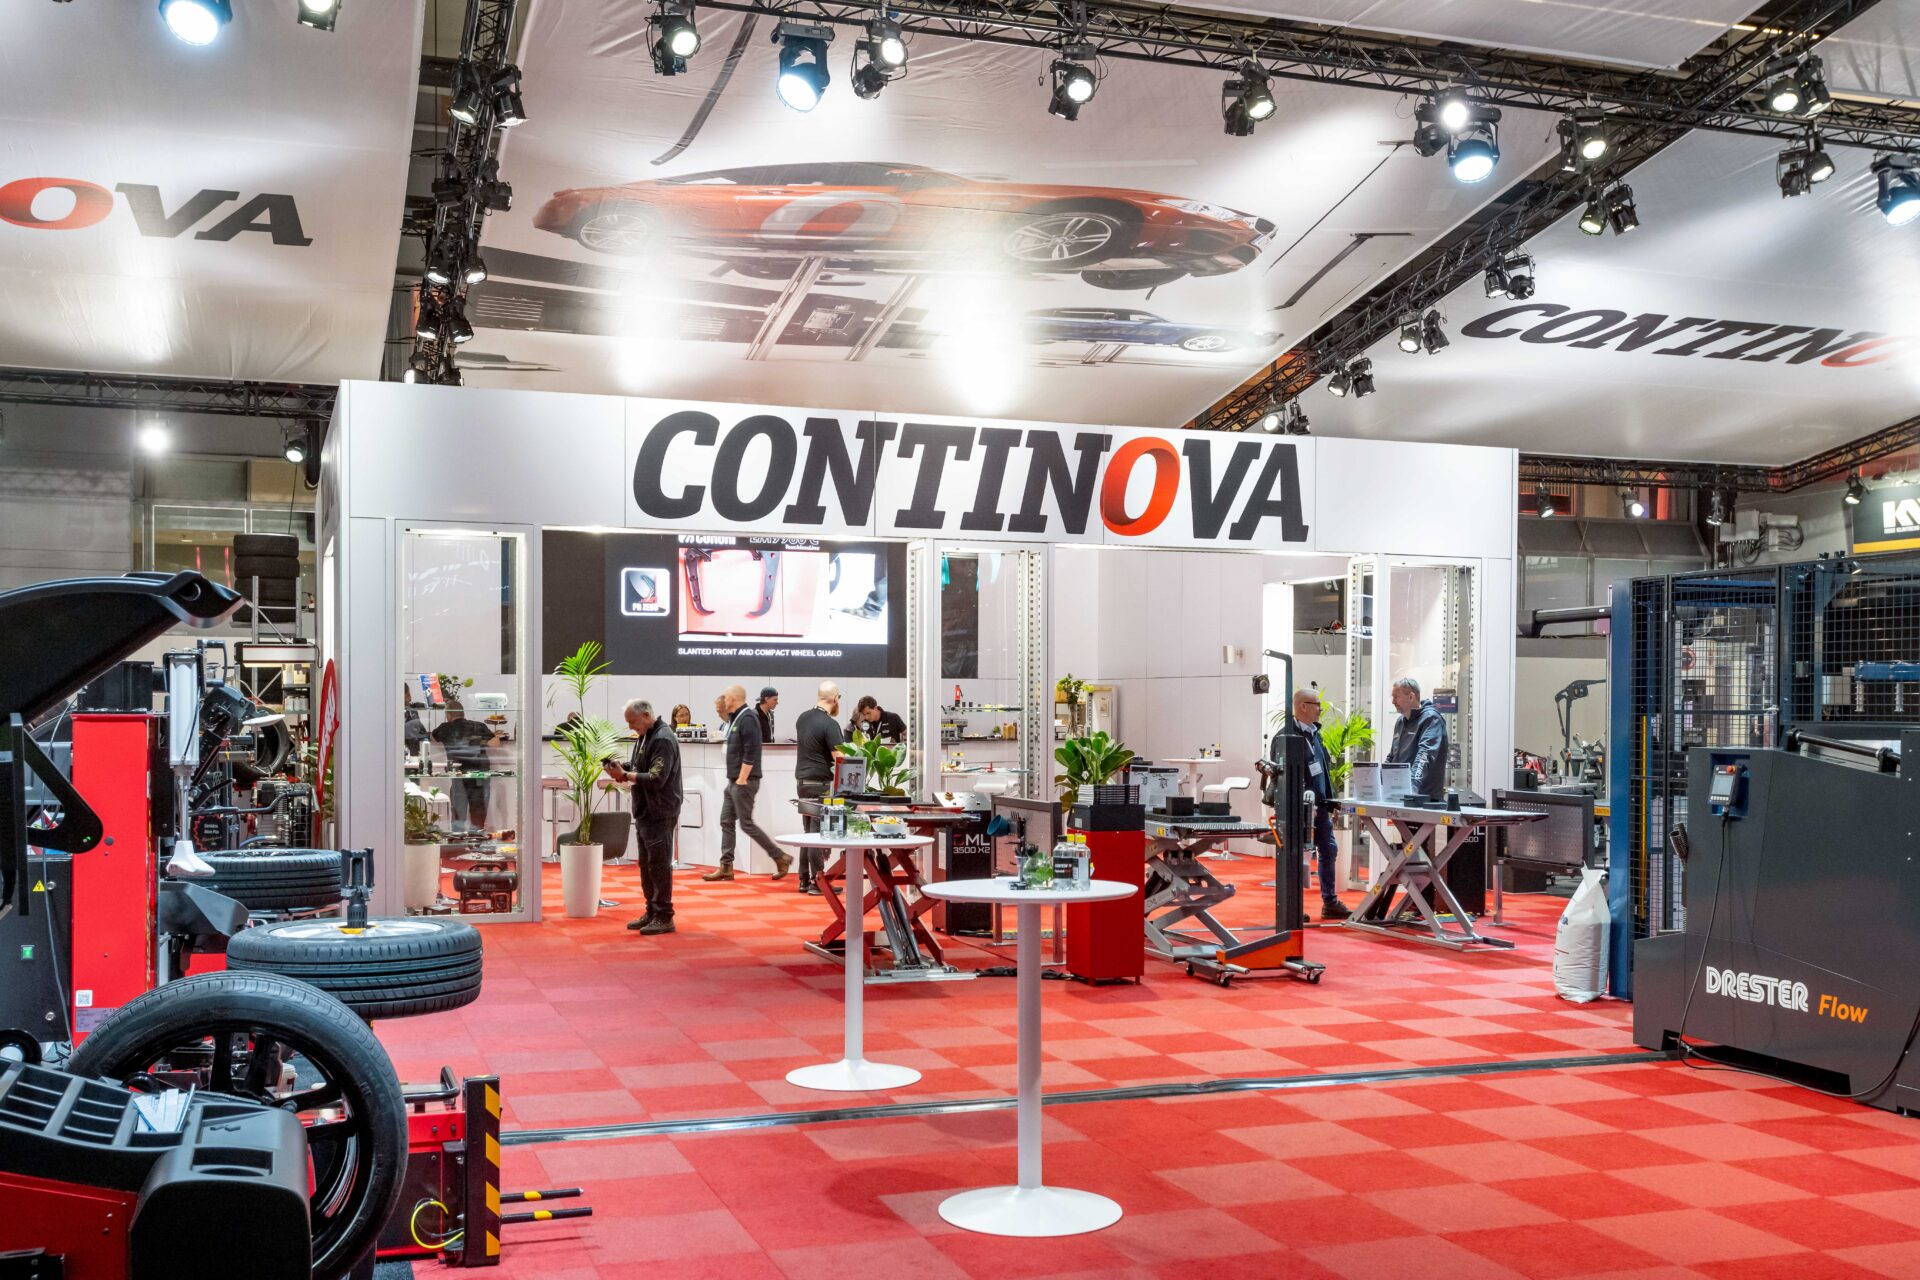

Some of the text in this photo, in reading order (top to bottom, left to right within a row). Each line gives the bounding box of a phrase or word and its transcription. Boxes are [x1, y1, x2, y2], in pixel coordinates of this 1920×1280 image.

[633, 411, 1309, 542] CONTINOVA
[678, 647, 842, 658] SLANTED FRONT AND COMPACT WHEEL GUARD
[953, 846, 991, 854] 3500 X2
[1706, 966, 1869, 1024] DRESTER Flow
